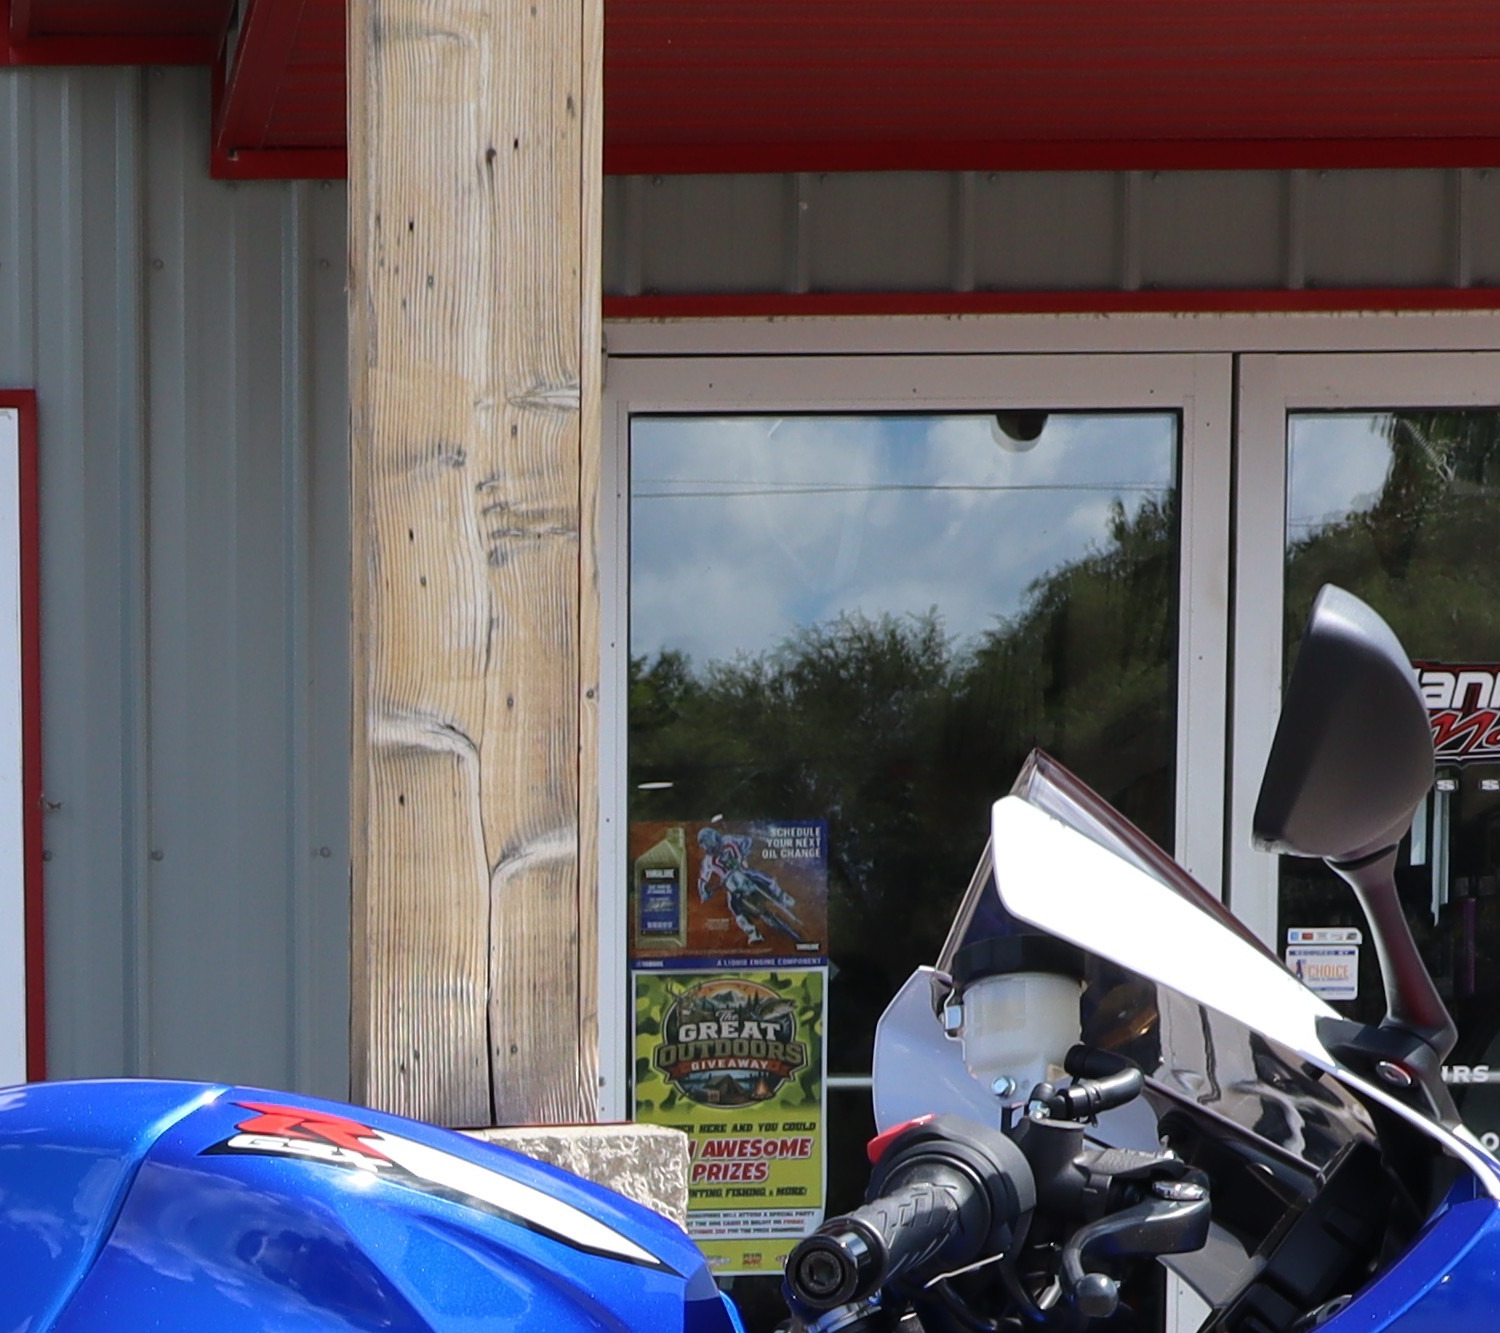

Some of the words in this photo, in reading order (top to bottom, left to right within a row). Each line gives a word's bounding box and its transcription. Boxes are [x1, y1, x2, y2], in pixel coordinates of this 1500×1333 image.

[769, 826, 822, 838] SCHEDULE
[766, 837, 794, 848] YOUR
[795, 837, 822, 848] NEXT
[761, 848, 778, 859] OIL
[780, 848, 822, 859] CHANGE
[750, 958, 775, 966] ENGINE
[777, 957, 822, 966] COMPONENT
[1308, 964, 1349, 978] CHOICE
[714, 1009, 739, 1022] The
[678, 1021, 782, 1043] GREAT
[658, 1039, 802, 1067] OUTDOORS
[690, 1058, 769, 1071] GIVEAWAY
[699, 1123, 727, 1133] HERE
[731, 1123, 753, 1133] AND
[758, 1123, 778, 1132] YOU
[783, 1122, 816, 1131] COULD
[700, 1138, 814, 1158] AWESOME
[690, 1161, 769, 1183] PRIZES
